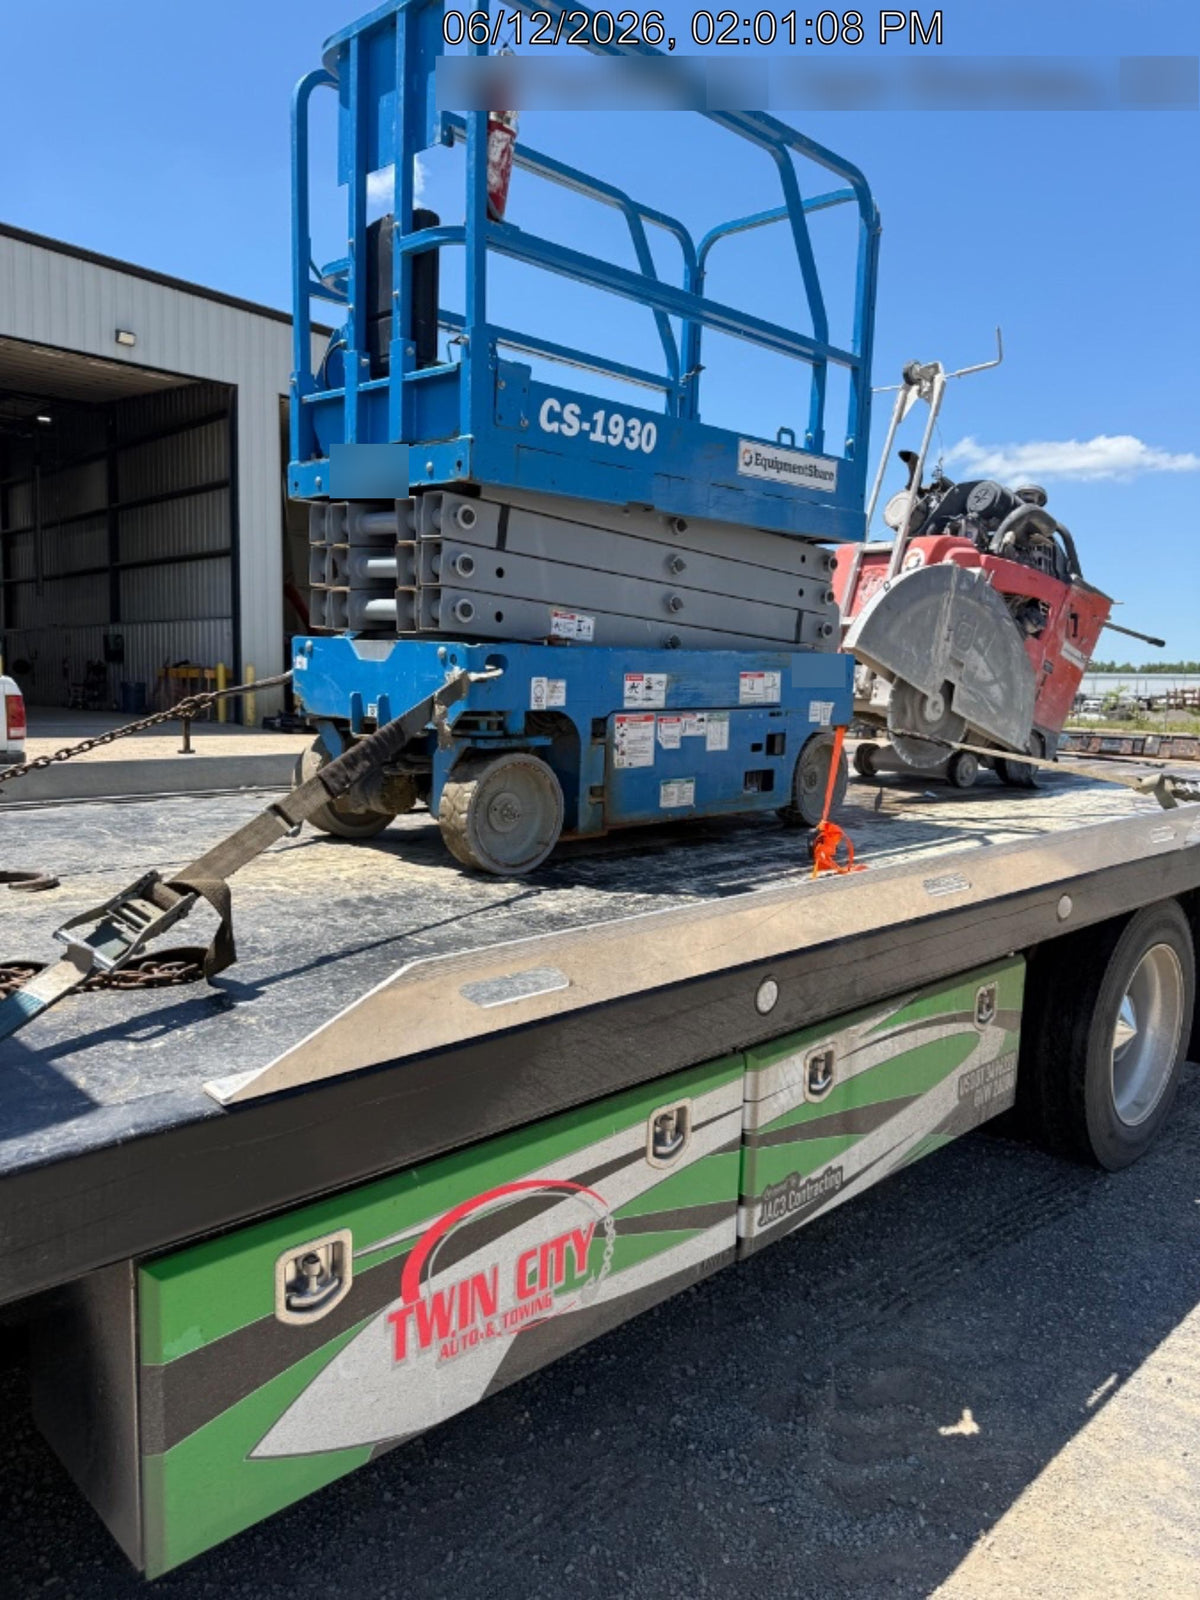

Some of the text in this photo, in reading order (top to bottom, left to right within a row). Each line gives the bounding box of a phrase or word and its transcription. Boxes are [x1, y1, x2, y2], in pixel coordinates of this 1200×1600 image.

[539, 397, 657, 454] CS-1930
[754, 452, 835, 482] EquipmentShare
[387, 1221, 595, 1363] TWIN CITY
[440, 1328, 479, 1359] AUTO
[502, 1292, 553, 1329] TOWING
